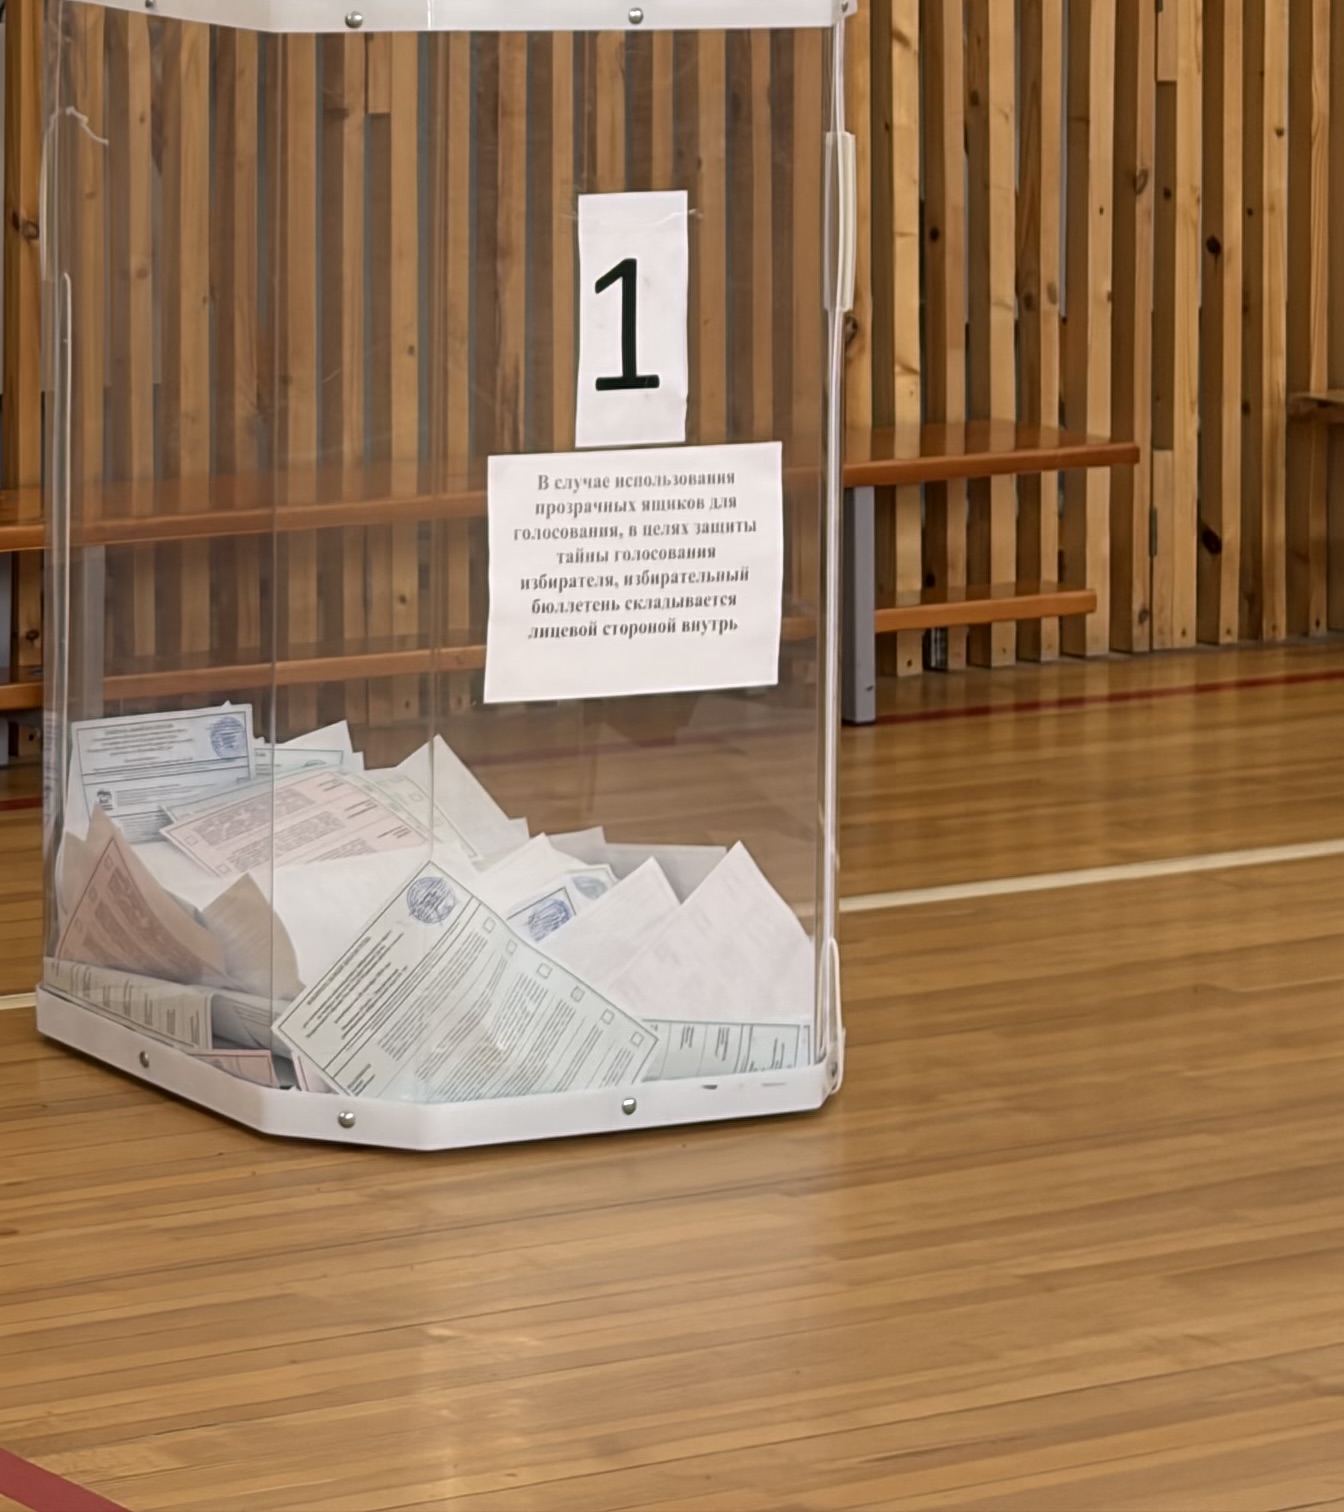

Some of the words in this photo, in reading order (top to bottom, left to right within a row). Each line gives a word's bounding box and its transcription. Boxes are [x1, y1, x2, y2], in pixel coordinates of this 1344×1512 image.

[594, 258, 660, 391] 1
[537, 474, 550, 491] В
[553, 476, 610, 494] случае
[614, 472, 735, 489] использования
[535, 500, 637, 521] прозрачных
[641, 497, 705, 513] ящиков
[708, 496, 737, 512] для
[513, 525, 624, 541] голосования,
[628, 524, 638, 538] в
[642, 522, 689, 537] целях
[694, 519, 757, 536] защиты
[556, 547, 609, 565] тайны
[614, 546, 717, 563] голосования
[520, 573, 620, 595] избирателя,
[623, 565, 750, 590] избирательный
[531, 598, 621, 615] бюллетень
[624, 594, 737, 612] складывается
[527, 620, 598, 640] лицевой
[602, 617, 677, 640] стороной
[681, 618, 739, 637] внутрь
